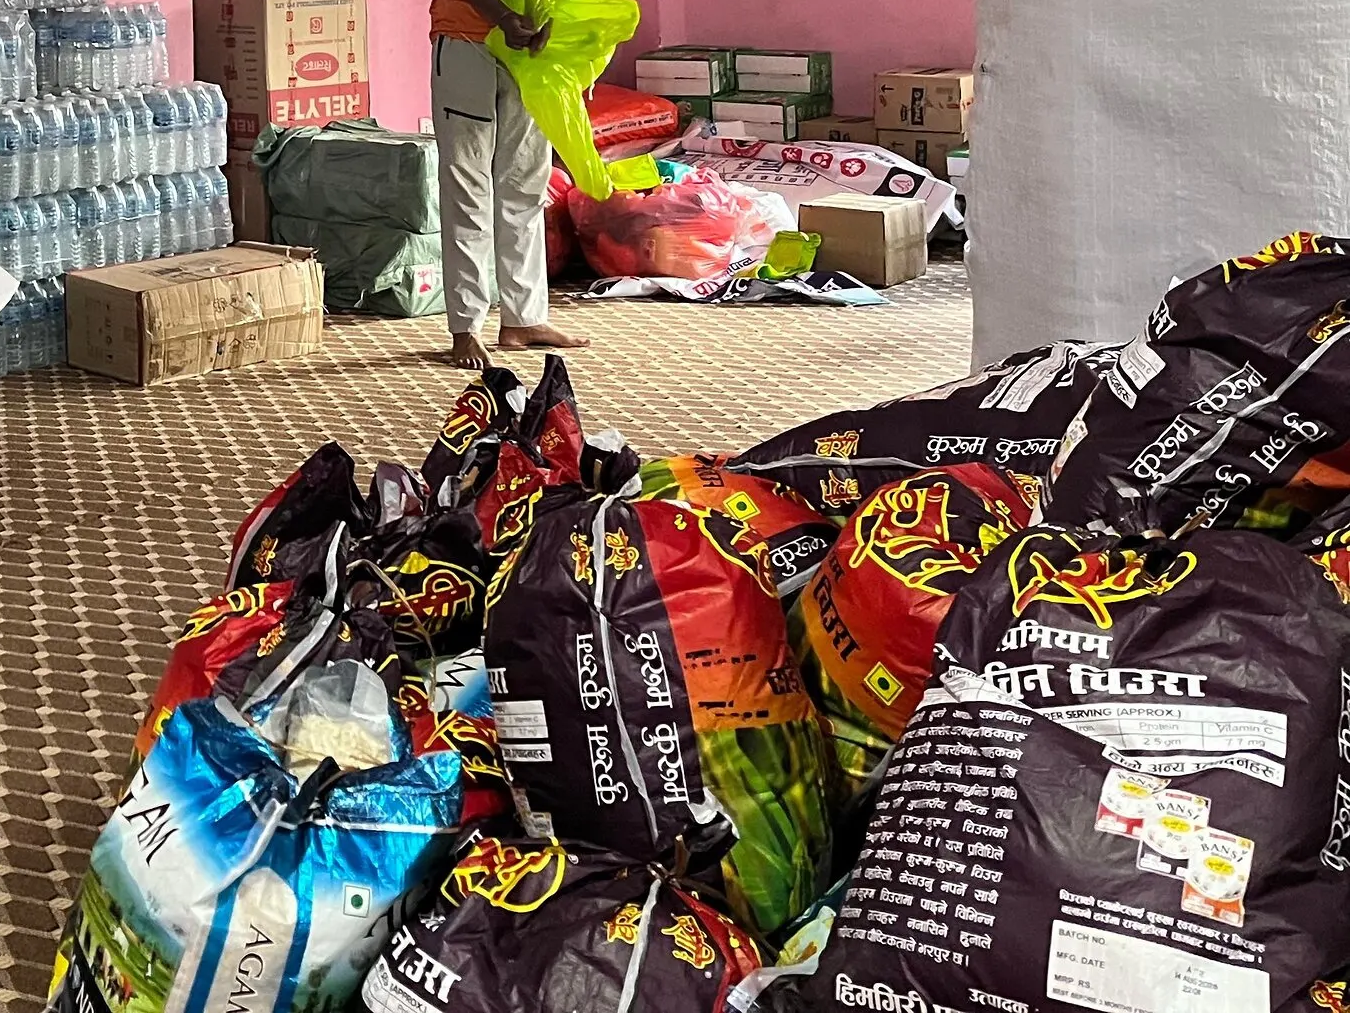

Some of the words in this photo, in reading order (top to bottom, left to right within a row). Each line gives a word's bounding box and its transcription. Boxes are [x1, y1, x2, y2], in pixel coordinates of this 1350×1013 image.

[276, 94, 361, 122] RELYTE
[926, 434, 989, 463] कुरूम
[996, 437, 1061, 464] कुरूम
[576, 633, 613, 710] कुरूम
[624, 630, 673, 709] कुरूम
[1066, 707, 1112, 720] SERVING
[1116, 707, 1182, 719] (APPROX.)
[1138, 722, 1180, 733] Protein
[1216, 722, 1258, 734] Vitamin
[1265, 727, 1274, 736] C
[586, 723, 629, 806] कुरूम
[641, 721, 690, 805] कुरूम
[1156, 801, 1200, 820] BANSI
[1201, 843, 1244, 863] BANSI
[1058, 928, 1089, 943] BATCH
[1091, 935, 1107, 946] NO.
[1056, 951, 1079, 964] MFG.
[1080, 955, 1106, 970] DATE
[1054, 973, 1074, 984] MRP
